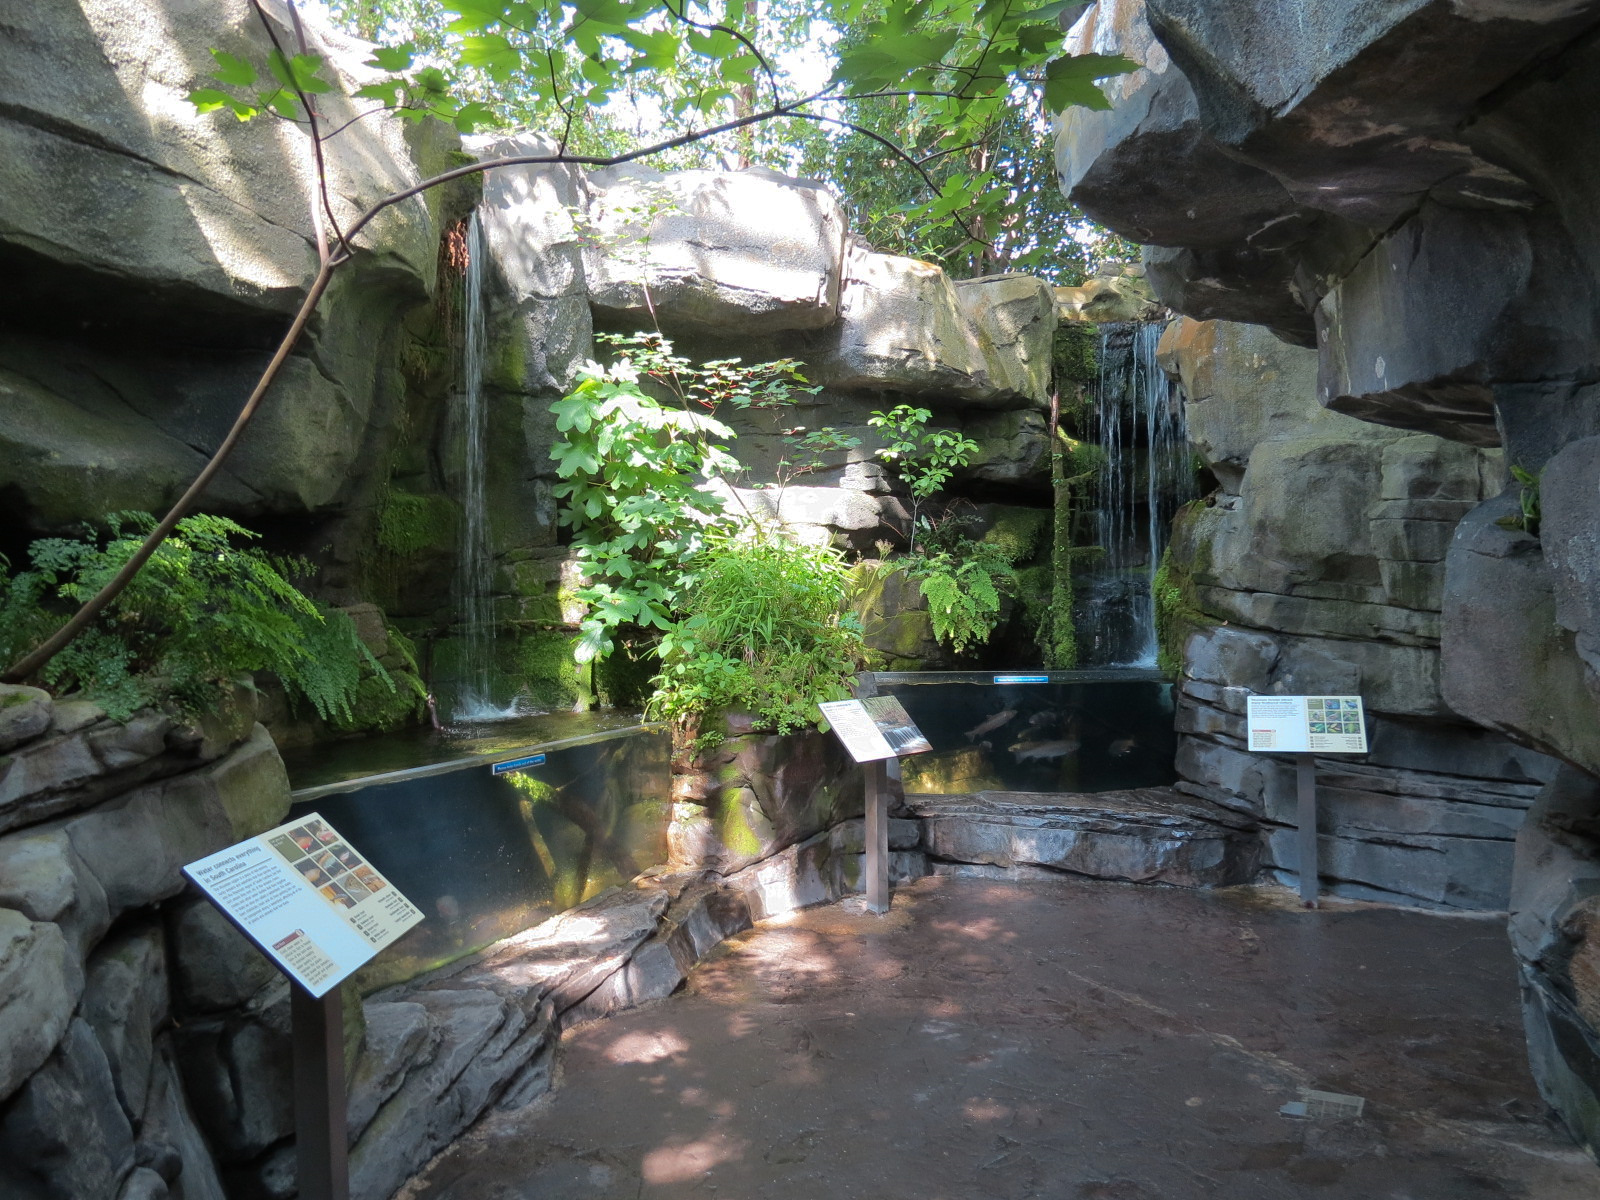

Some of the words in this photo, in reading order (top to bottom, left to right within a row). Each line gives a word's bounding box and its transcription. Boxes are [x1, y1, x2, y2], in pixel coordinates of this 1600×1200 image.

[196, 866, 213, 876] Water
[214, 856, 236, 869] connects
[236, 846, 261, 859] everything
[210, 870, 226, 880] South
[226, 862, 246, 873] Carolina
